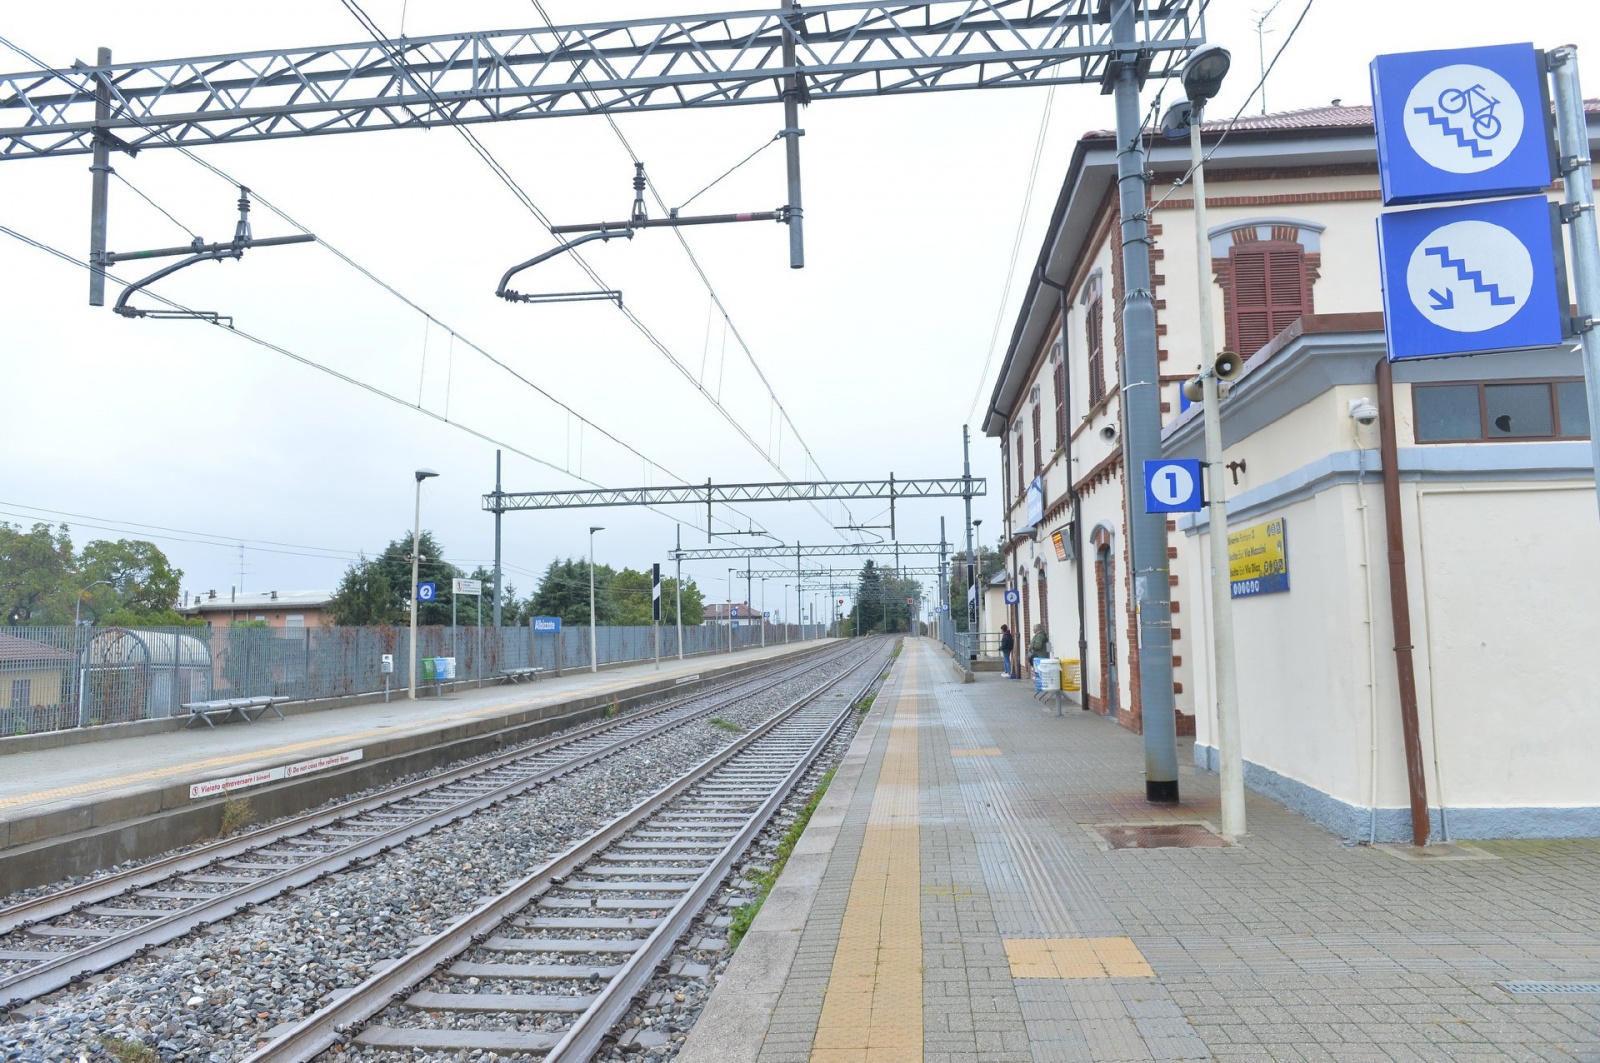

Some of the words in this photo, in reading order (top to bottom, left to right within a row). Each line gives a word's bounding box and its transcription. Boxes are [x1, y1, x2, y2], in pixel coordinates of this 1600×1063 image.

[1165, 472, 1177, 498] 1
[423, 588, 429, 597] 2
[292, 766, 300, 774] Do
[201, 783, 221, 793] Vietato
[221, 777, 253, 789] attraversare
[256, 772, 271, 782] binari
